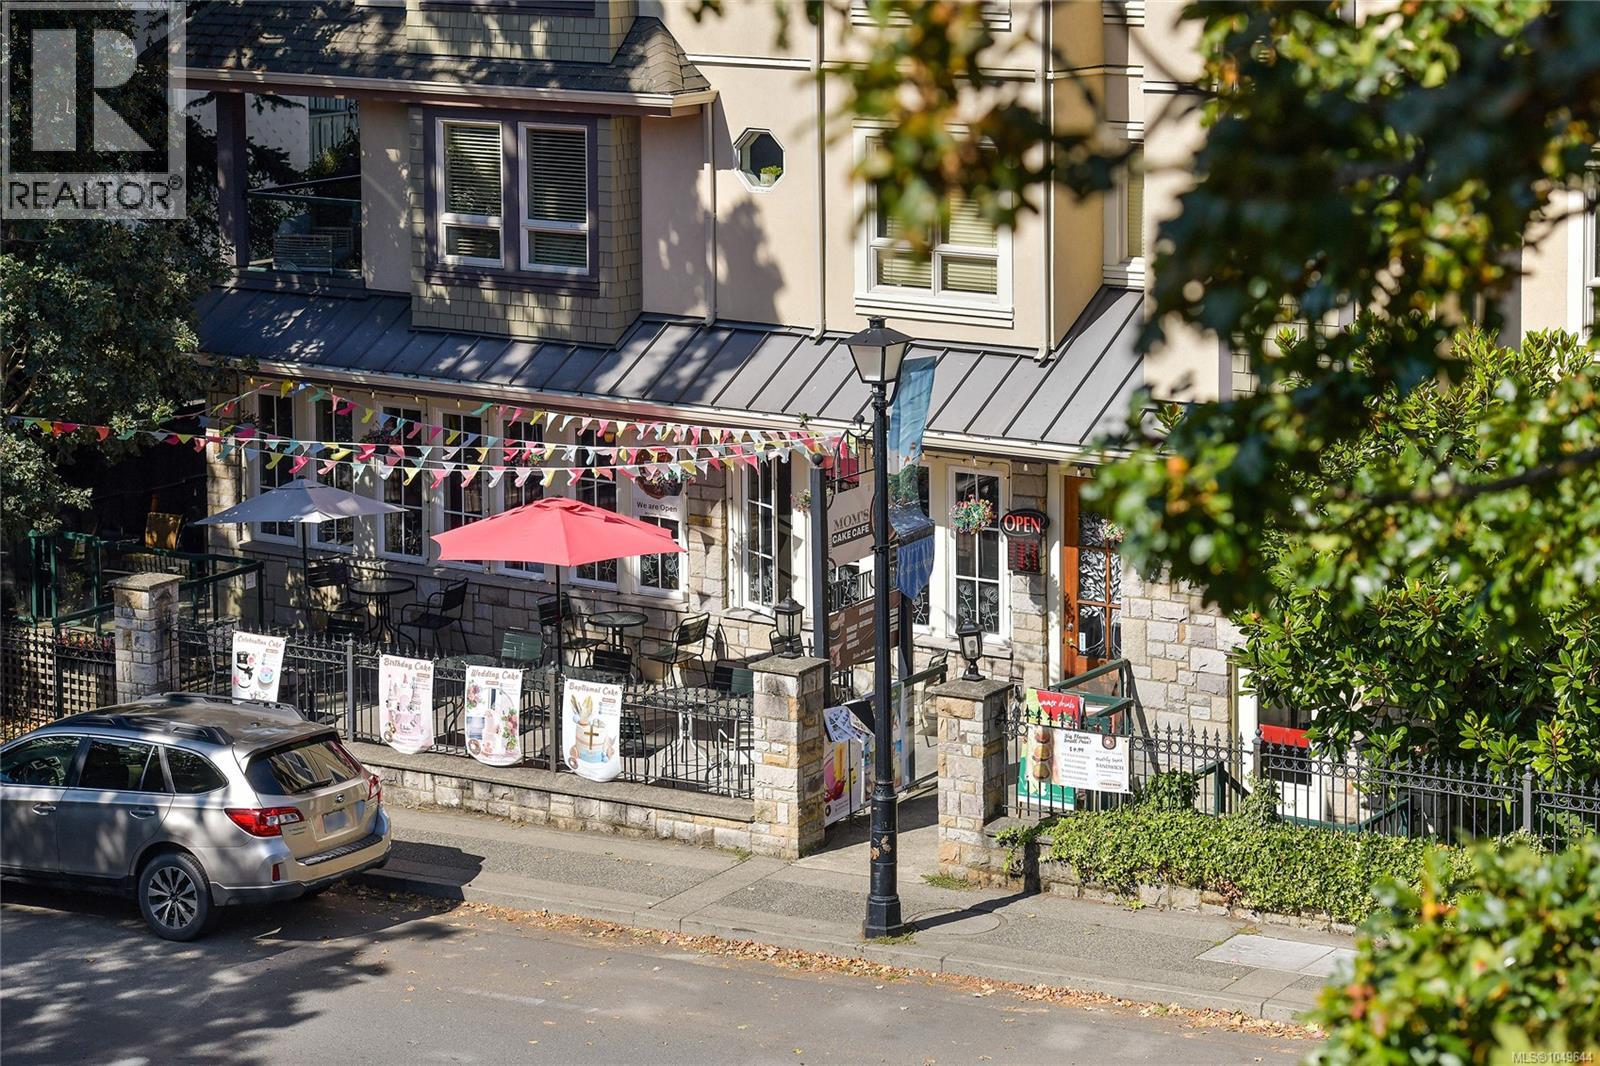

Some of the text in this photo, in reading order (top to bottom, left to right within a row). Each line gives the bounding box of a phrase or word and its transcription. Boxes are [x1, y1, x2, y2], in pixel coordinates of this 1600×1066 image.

[637, 501, 647, 509] We
[660, 504, 678, 512] Open
[833, 508, 869, 531] MOM'S
[1004, 514, 1041, 534] OPEN
[832, 524, 870, 544] CAKE CAFE
[268, 639, 282, 648] Cake
[383, 657, 431, 672] Birthday Cake
[471, 669, 519, 681] Wedding Cake
[602, 687, 619, 696] Cake
